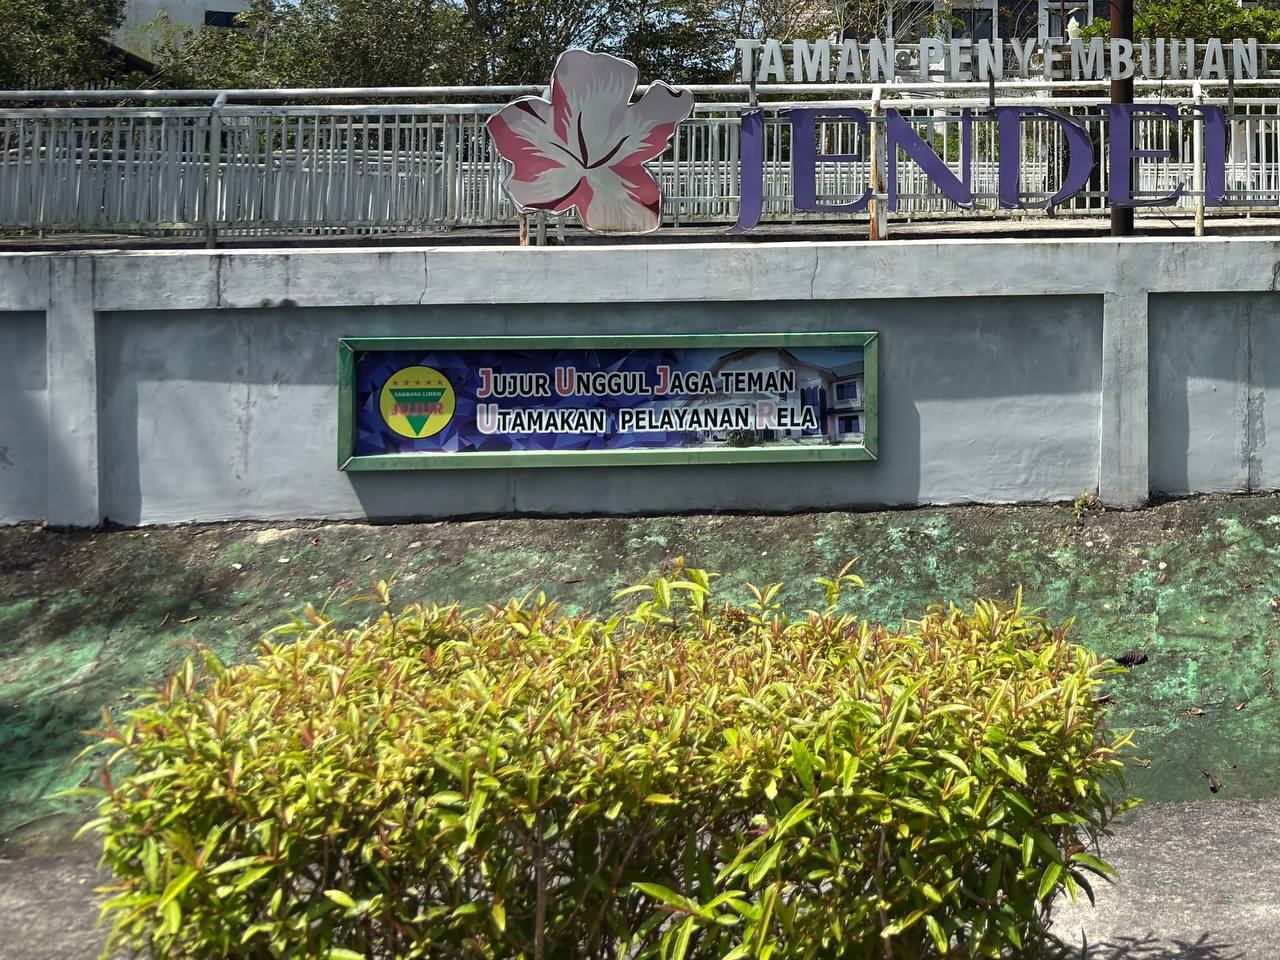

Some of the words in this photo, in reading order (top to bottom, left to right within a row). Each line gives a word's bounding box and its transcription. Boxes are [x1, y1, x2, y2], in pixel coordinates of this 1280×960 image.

[735, 38, 894, 82] TAMAN
[920, 36, 1257, 81] PENYEMBUHAN
[477, 367, 551, 398] JUJUR
[554, 366, 652, 397] UNGGUL
[655, 365, 715, 396] JAGA
[720, 369, 796, 394] TEMAN
[391, 402, 444, 416] JUJUR
[477, 403, 605, 434] UTAMAKAN
[619, 406, 750, 431] PELAYANAN
[756, 400, 818, 430] RELA
